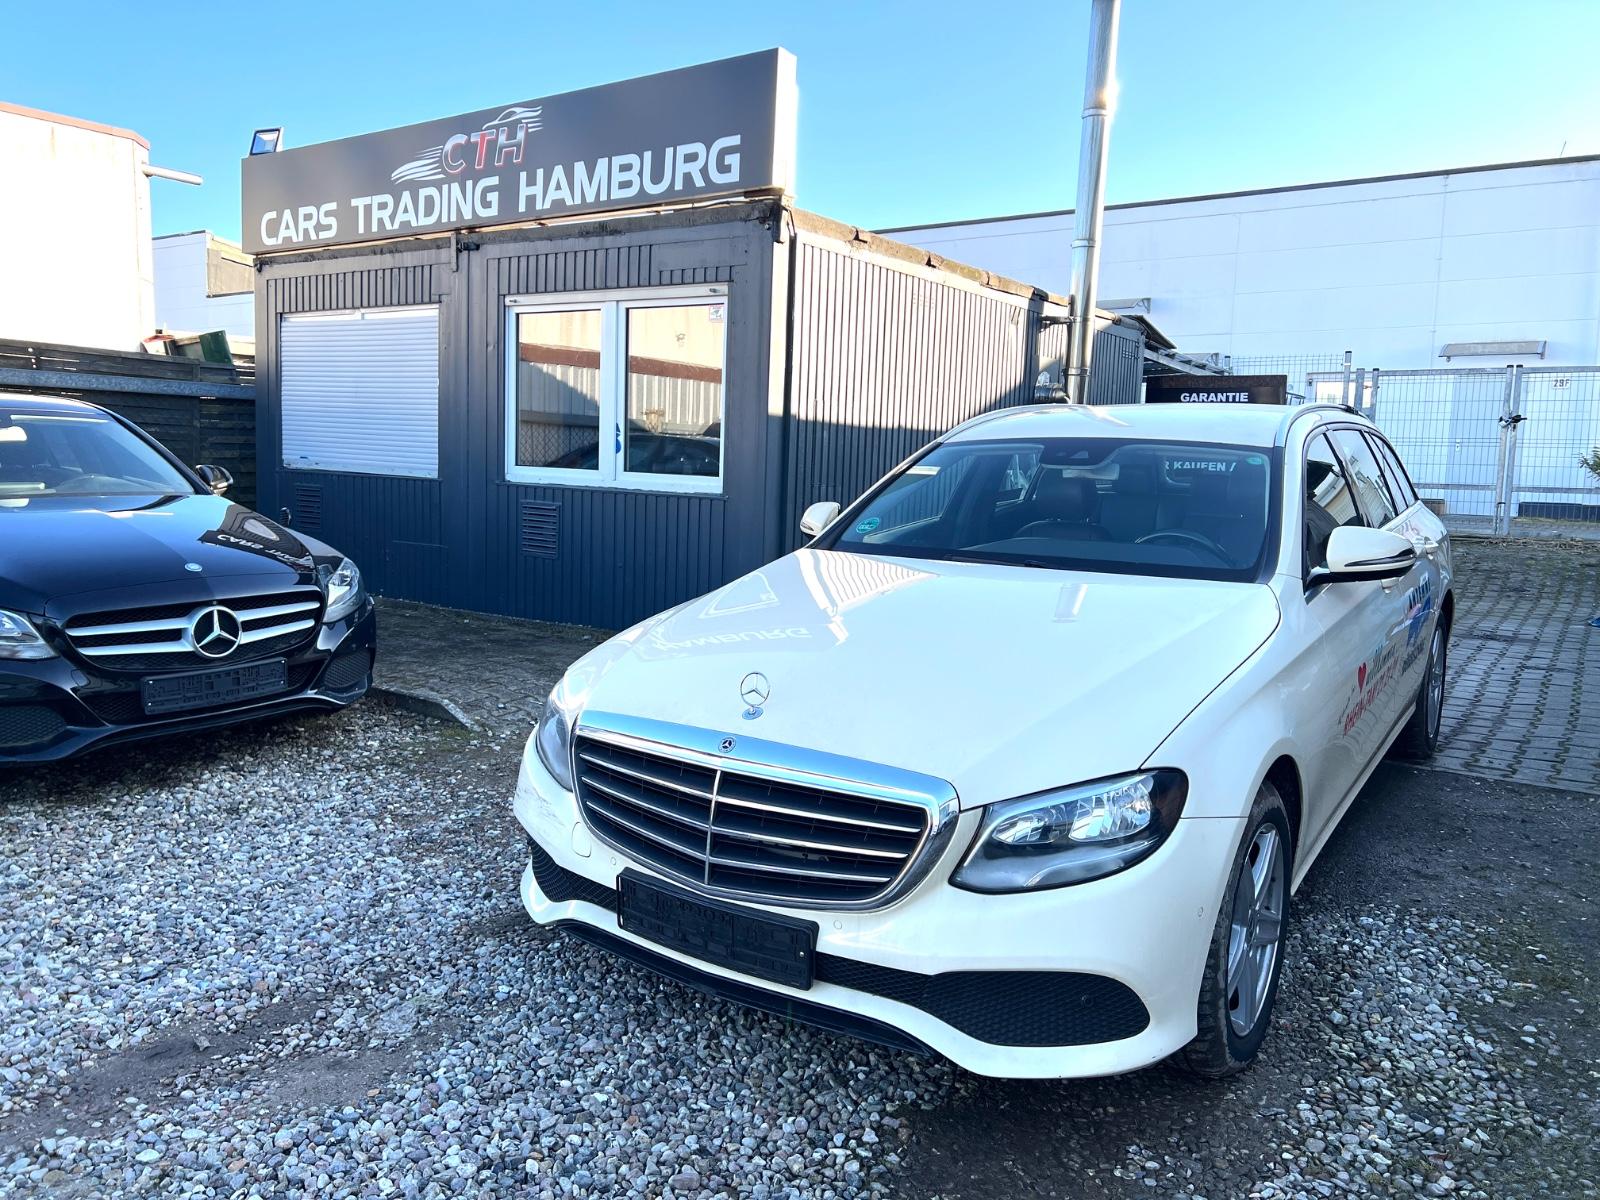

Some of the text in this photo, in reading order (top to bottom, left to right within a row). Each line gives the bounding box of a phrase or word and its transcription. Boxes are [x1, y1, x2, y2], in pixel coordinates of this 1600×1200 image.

[442, 122, 528, 175] CTH
[261, 133, 742, 246] CARS TRADING HAMBURG
[1180, 391, 1249, 403] GARANTIE
[1173, 460, 1226, 472] KAUFEN
